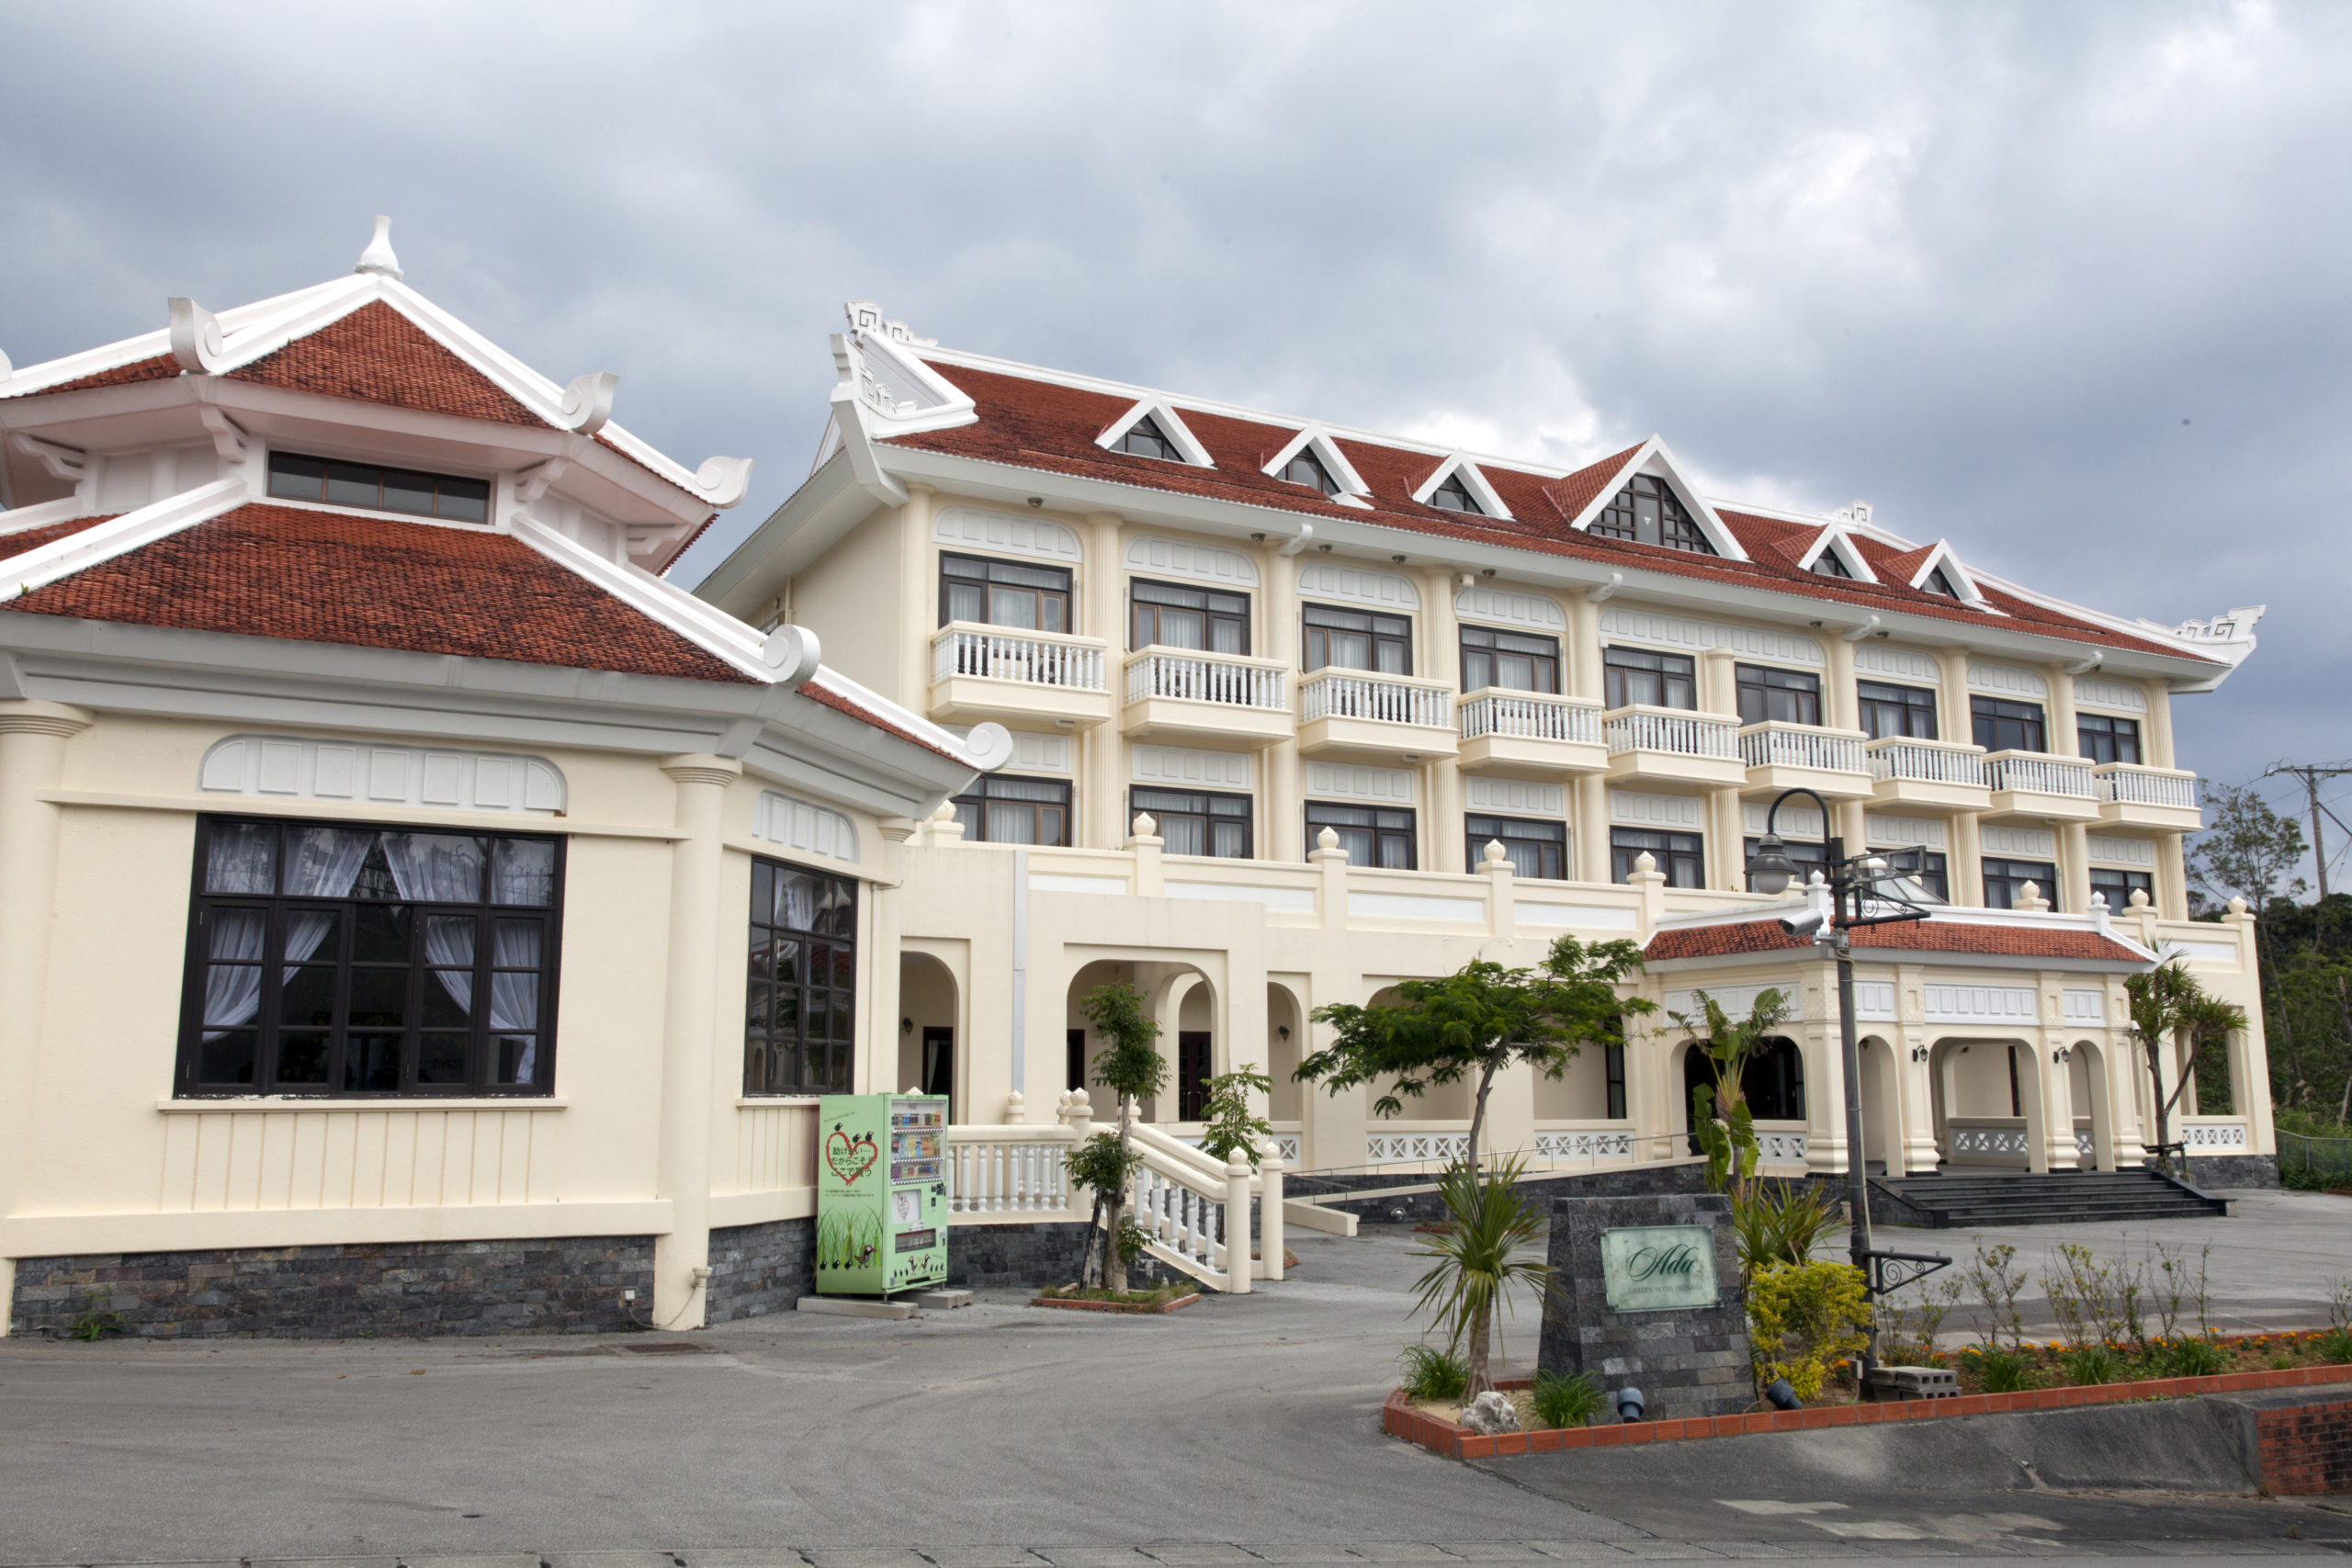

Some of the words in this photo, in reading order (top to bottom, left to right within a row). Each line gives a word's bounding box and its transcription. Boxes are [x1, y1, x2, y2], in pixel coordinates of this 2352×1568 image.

[1625, 1244, 1699, 1282] Ada
[1628, 1286, 1654, 1294] GARDEN
[1655, 1285, 1675, 1293] HOTEL
